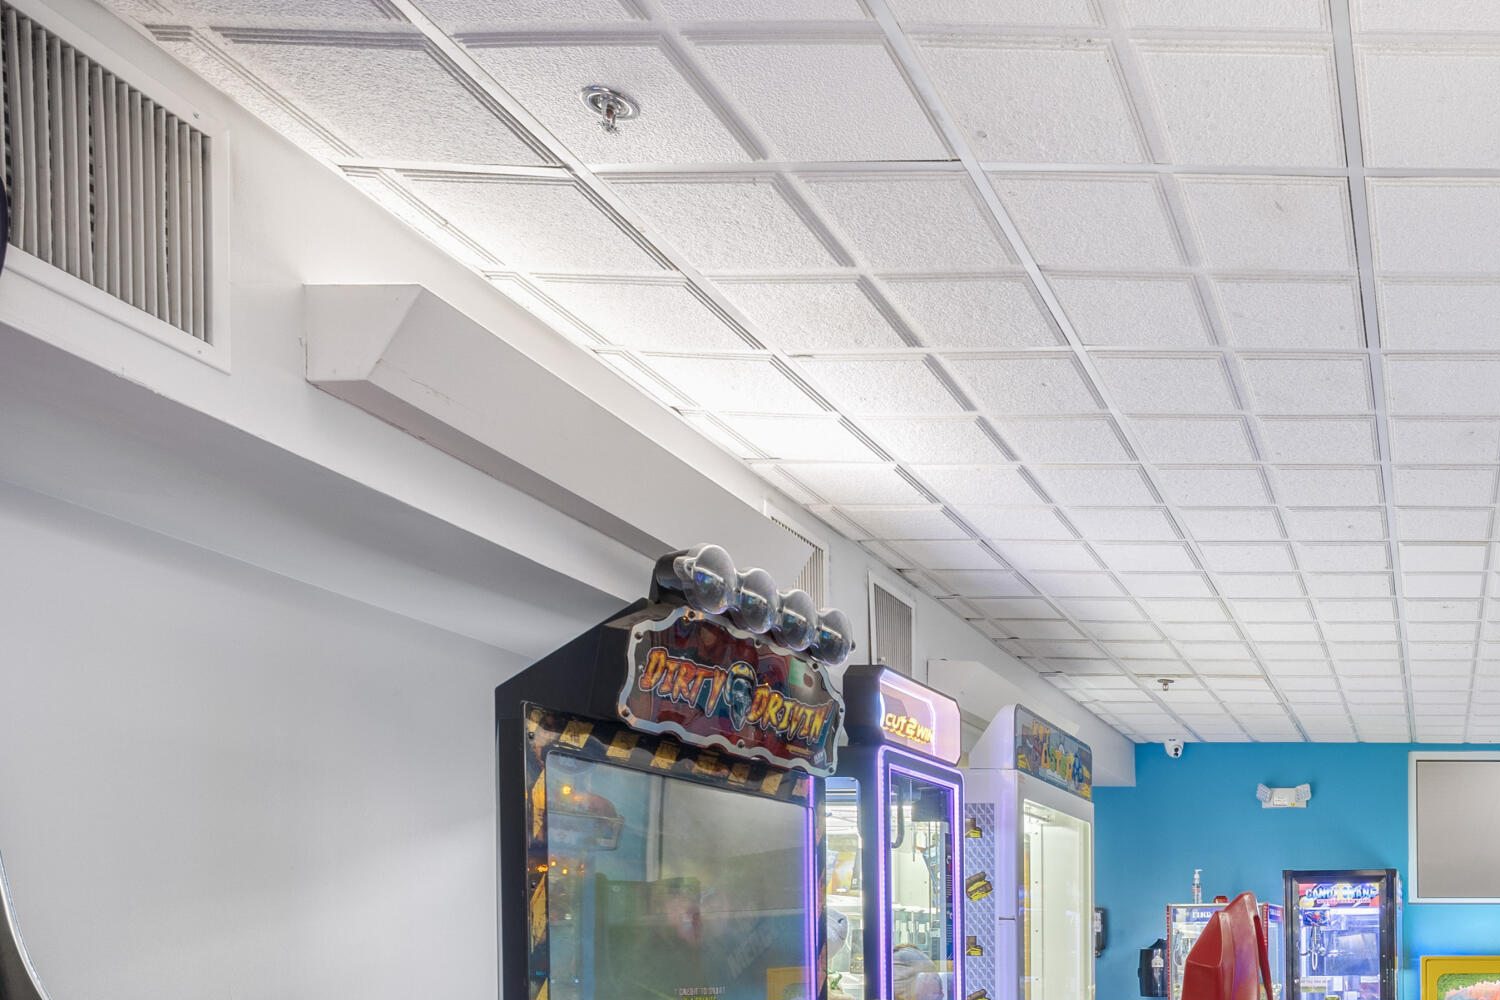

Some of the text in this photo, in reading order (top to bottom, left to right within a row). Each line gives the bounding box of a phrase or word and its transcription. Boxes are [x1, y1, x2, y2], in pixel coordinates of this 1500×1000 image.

[641, 648, 728, 717] DIRTY
[885, 712, 907, 731] CUT
[906, 717, 919, 732] 2
